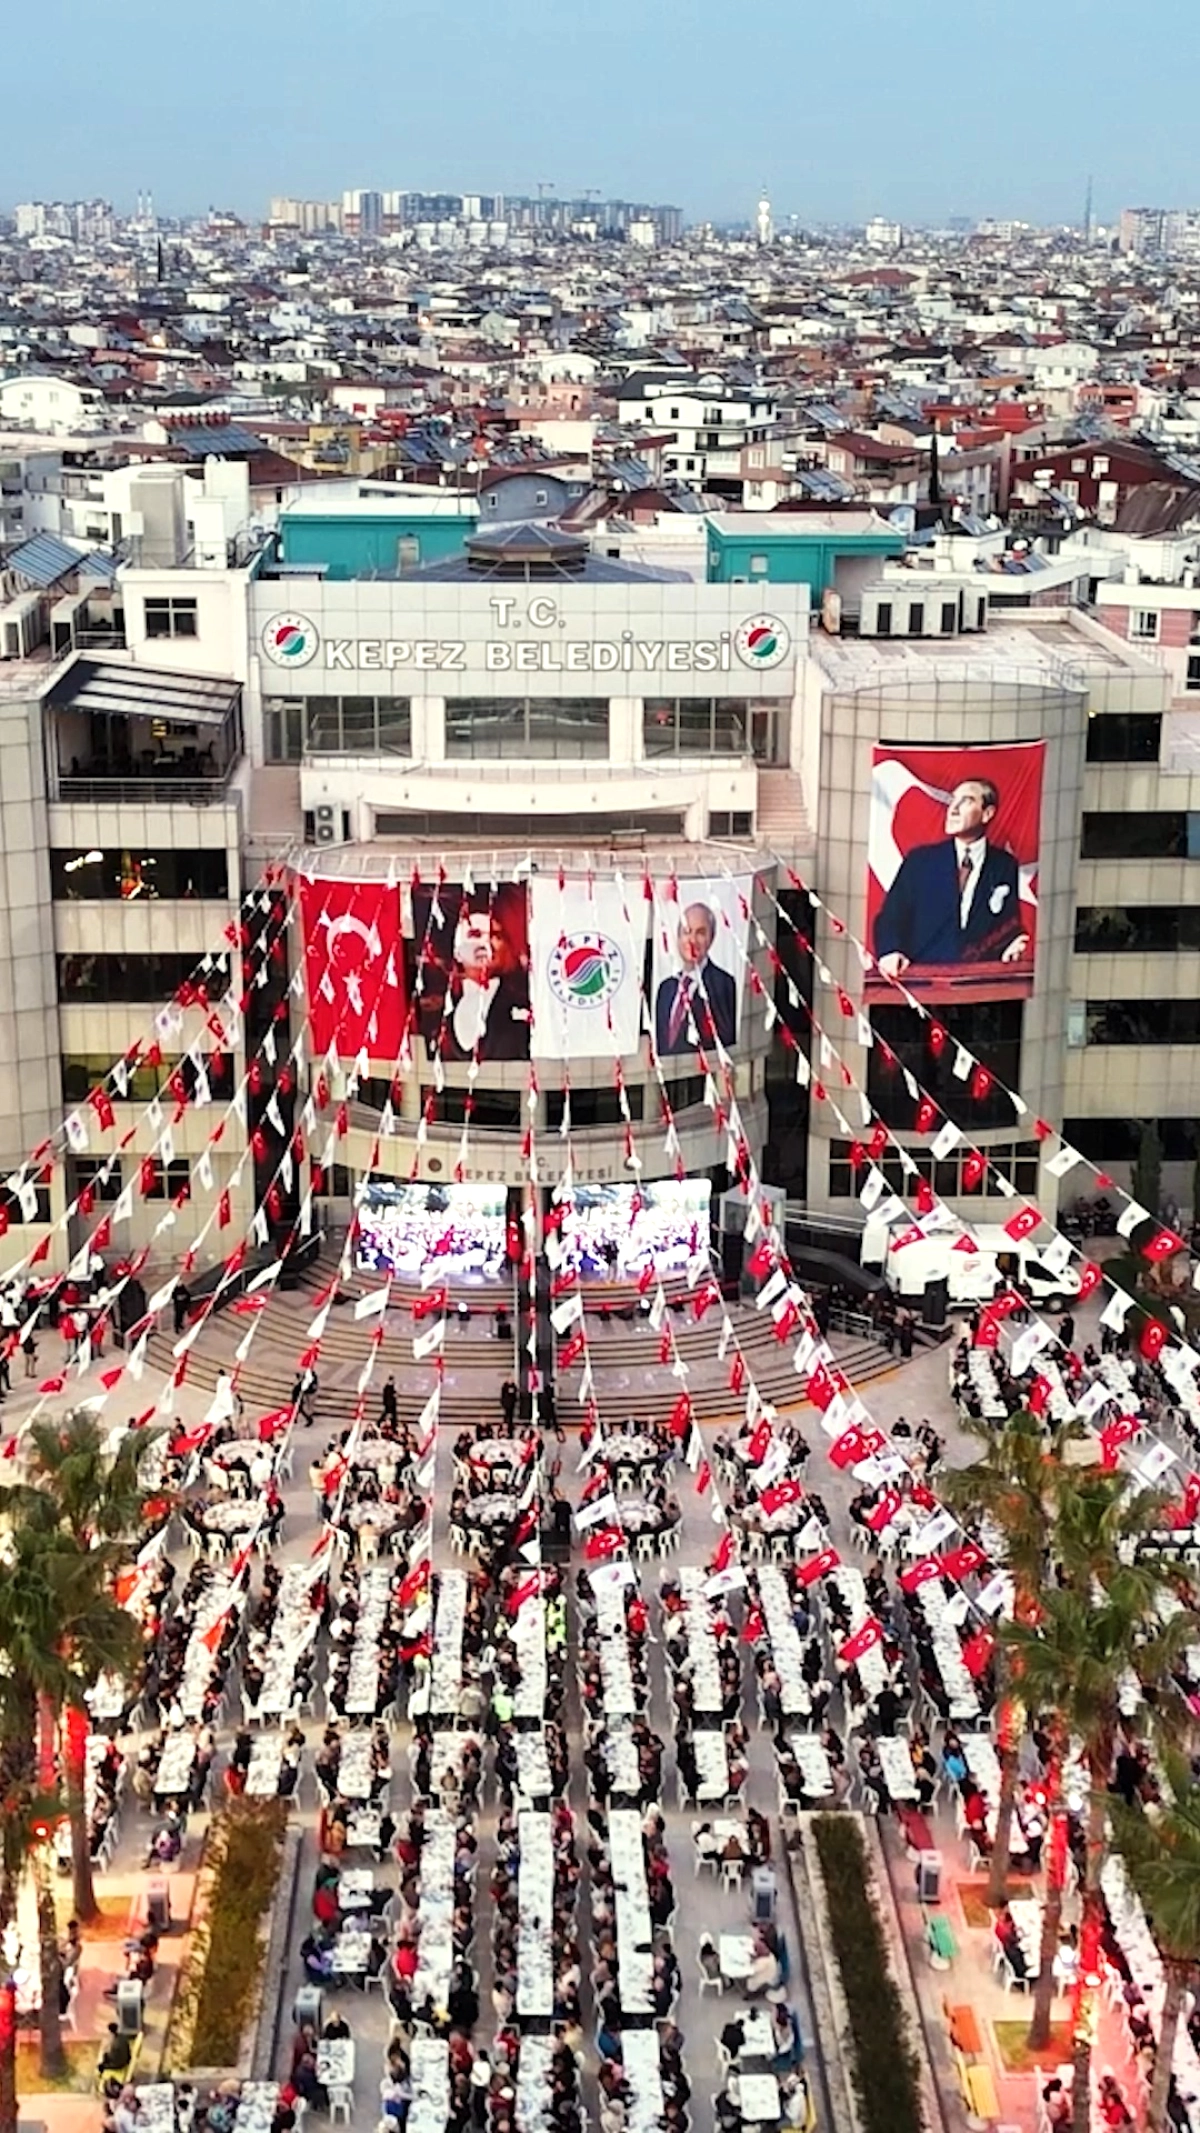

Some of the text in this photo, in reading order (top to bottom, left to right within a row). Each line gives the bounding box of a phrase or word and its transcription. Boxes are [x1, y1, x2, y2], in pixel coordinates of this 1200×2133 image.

[324, 640, 467, 671] KEPEZ
[485, 630, 731, 671] BELEDİYESİ
[456, 1168, 506, 1182] EPEZ
